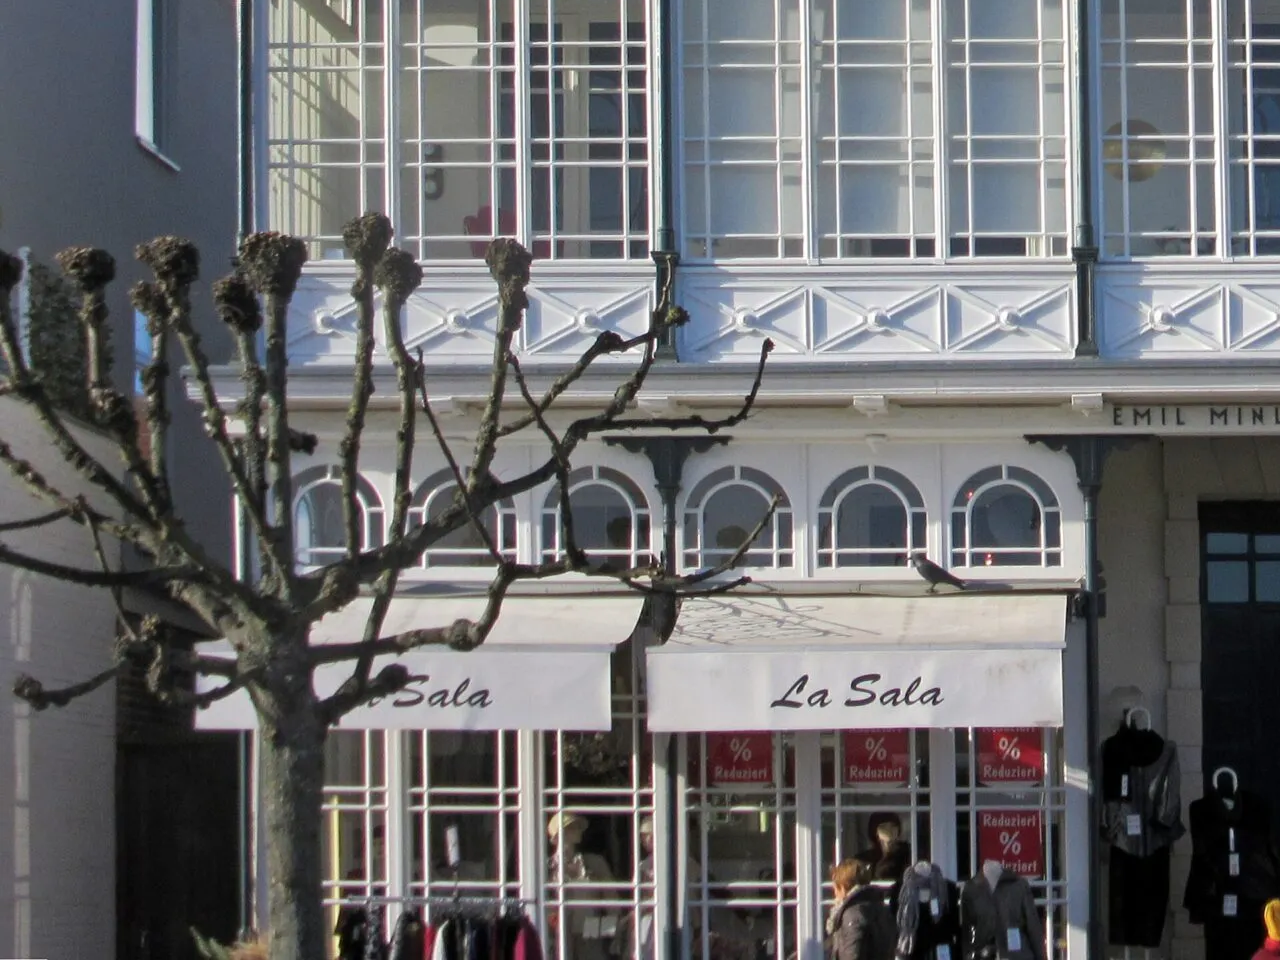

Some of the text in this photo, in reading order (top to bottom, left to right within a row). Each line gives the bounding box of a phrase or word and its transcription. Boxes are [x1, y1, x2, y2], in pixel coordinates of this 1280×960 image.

[1113, 407, 1185, 426] EMIL
[392, 674, 493, 709] Sala
[770, 673, 944, 708] La Sala
[730, 737, 752, 762] %
[865, 737, 887, 761] %
[998, 737, 1021, 761] %
[715, 765, 767, 779] Reduziert
[850, 766, 902, 779] Reduziert
[983, 764, 1037, 778] Reduziert
[983, 813, 1036, 827] Reduziert
[999, 830, 1021, 855] %
